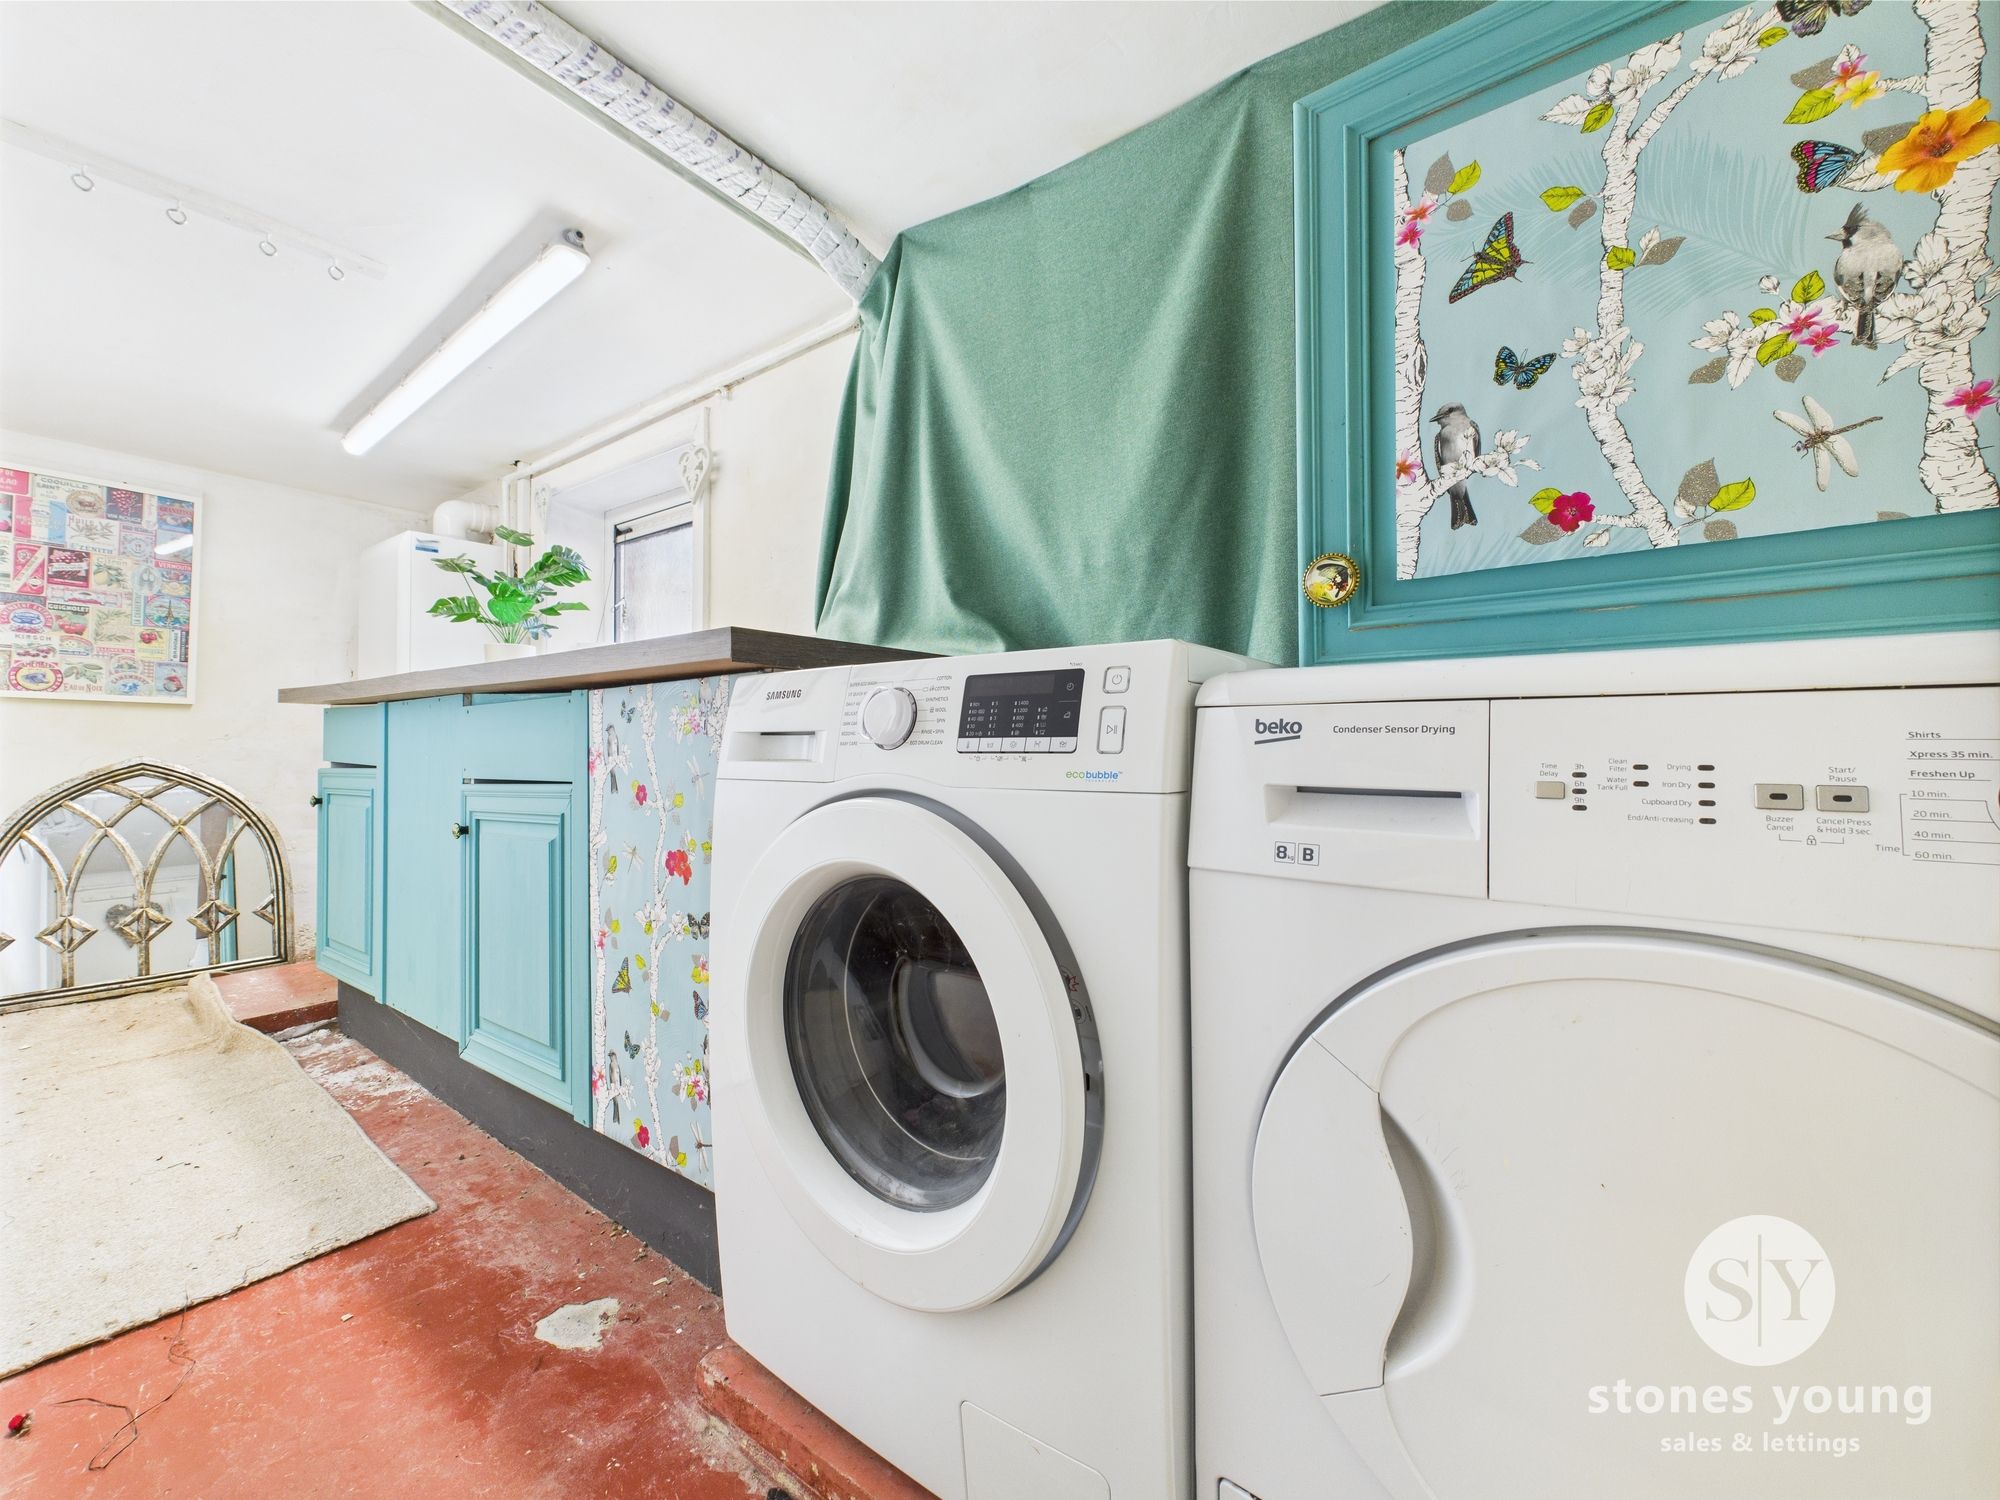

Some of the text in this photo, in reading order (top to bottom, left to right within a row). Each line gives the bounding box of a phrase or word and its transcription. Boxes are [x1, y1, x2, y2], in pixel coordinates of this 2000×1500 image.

[48, 603, 90, 613] GUIGNOLET
[766, 689, 802, 701] SAMSUNG
[1255, 718, 1303, 735] beko
[1333, 724, 1456, 736] Condenser Sensor Drying
[1908, 731, 1942, 739] Shirts
[1909, 750, 1993, 760] Xpress 35 min.
[1608, 757, 1628, 765] Clean
[1666, 763, 1692, 772] Drying
[1828, 766, 1856, 774] Start/
[1829, 774, 1858, 782] Pause
[1910, 769, 1976, 780] Freshen Up
[1678, 781, 1692, 790] Dry
[1911, 790, 1950, 799] 10 min.
[1574, 796, 1585, 804] 9h
[1641, 798, 1692, 808] Cupboard Dry
[1765, 814, 1794, 823] Buzzer
[1913, 810, 1953, 819] 20 min.
[1816, 816, 1872, 827] Cancel Press
[1766, 823, 1794, 832] Cancel
[1816, 825, 1871, 836] & Hold 3 sec
[1914, 830, 1954, 840] 40 min.
[1875, 843, 1901, 853] Time
[1303, 847, 1314, 862] B
[1914, 851, 1930, 859] 60
